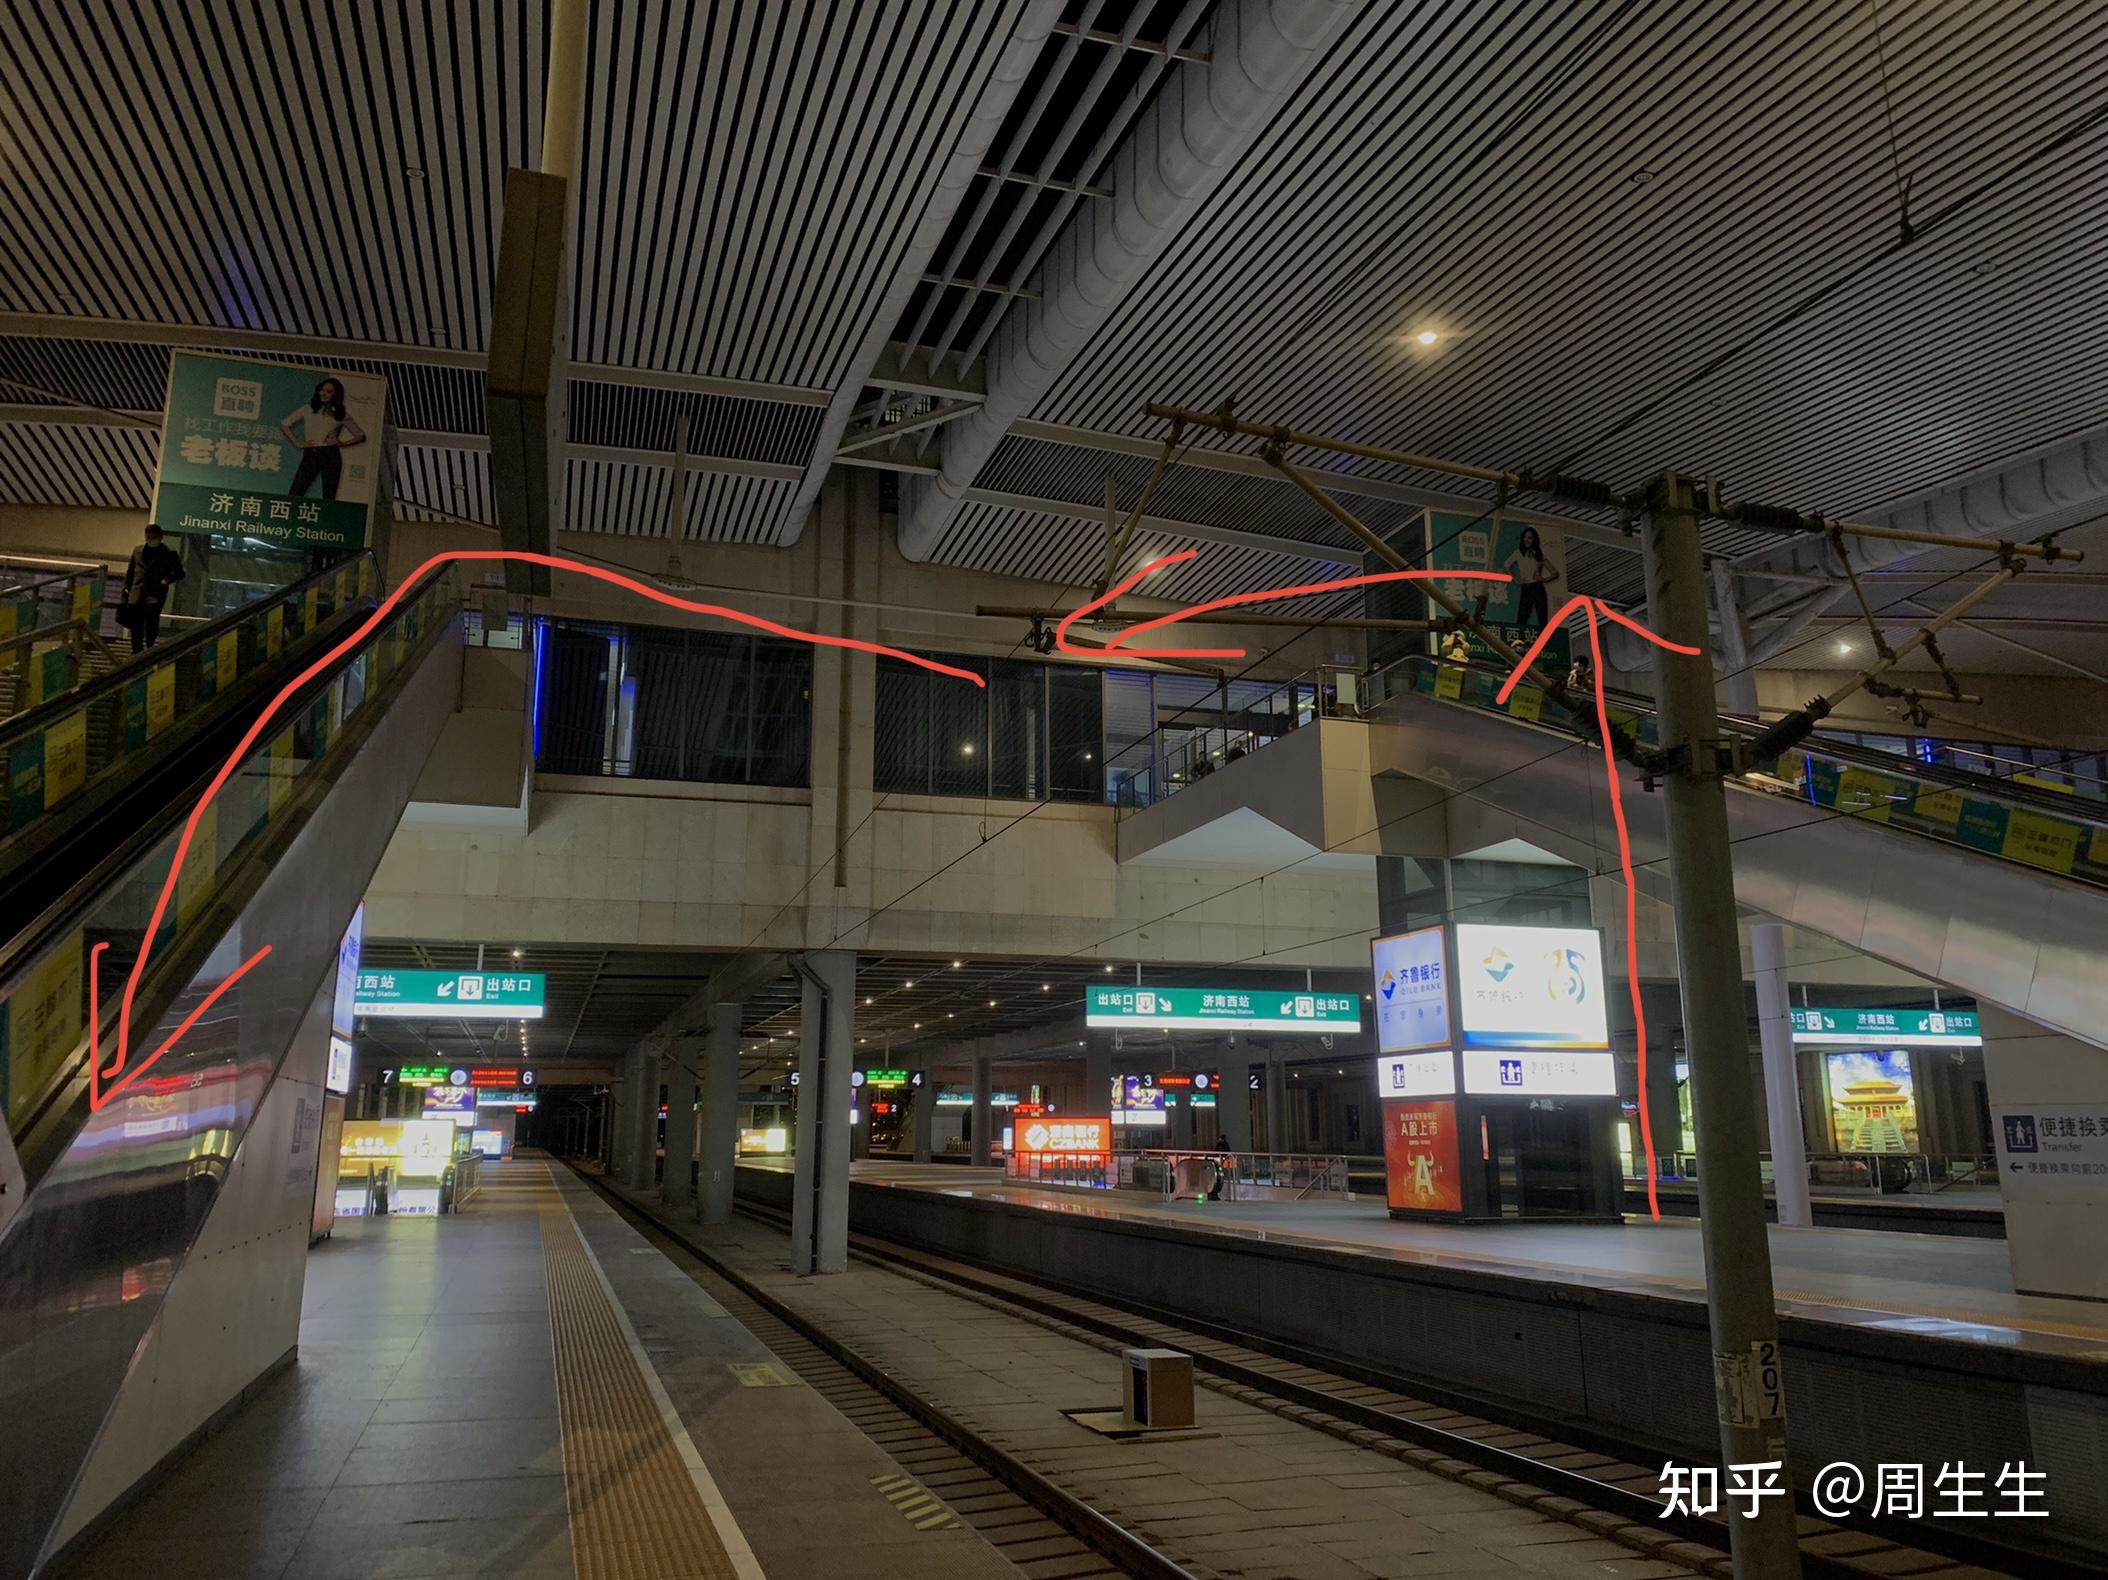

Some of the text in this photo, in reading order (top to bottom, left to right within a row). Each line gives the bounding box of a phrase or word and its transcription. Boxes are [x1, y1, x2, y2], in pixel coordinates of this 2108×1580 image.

[221, 384, 256, 398] BOSS
[180, 434, 282, 472] 老板谈
[210, 493, 321, 523] 济南西站
[180, 514, 344, 543] Jinanxi Railway Station
[1400, 962, 1440, 985] 齐鲁银行
[487, 978, 531, 992] 出站口
[1098, 993, 1133, 1006] 出站口
[1203, 994, 1250, 1008] 济南西站
[1316, 998, 1349, 1010] 出站口
[1858, 1013, 1895, 1025] 济南西站
[1946, 1017, 1972, 1028] 出站口
[383, 1070, 392, 1083] 7
[522, 1071, 533, 1085] 6
[791, 1072, 799, 1085] 5
[912, 1073, 921, 1086] 4
[1144, 1074, 1152, 1087] 3
[1249, 1075, 1259, 1088] 2
[2042, 1142, 2082, 1153] Transfer
[1760, 1342, 1780, 1416] 207
